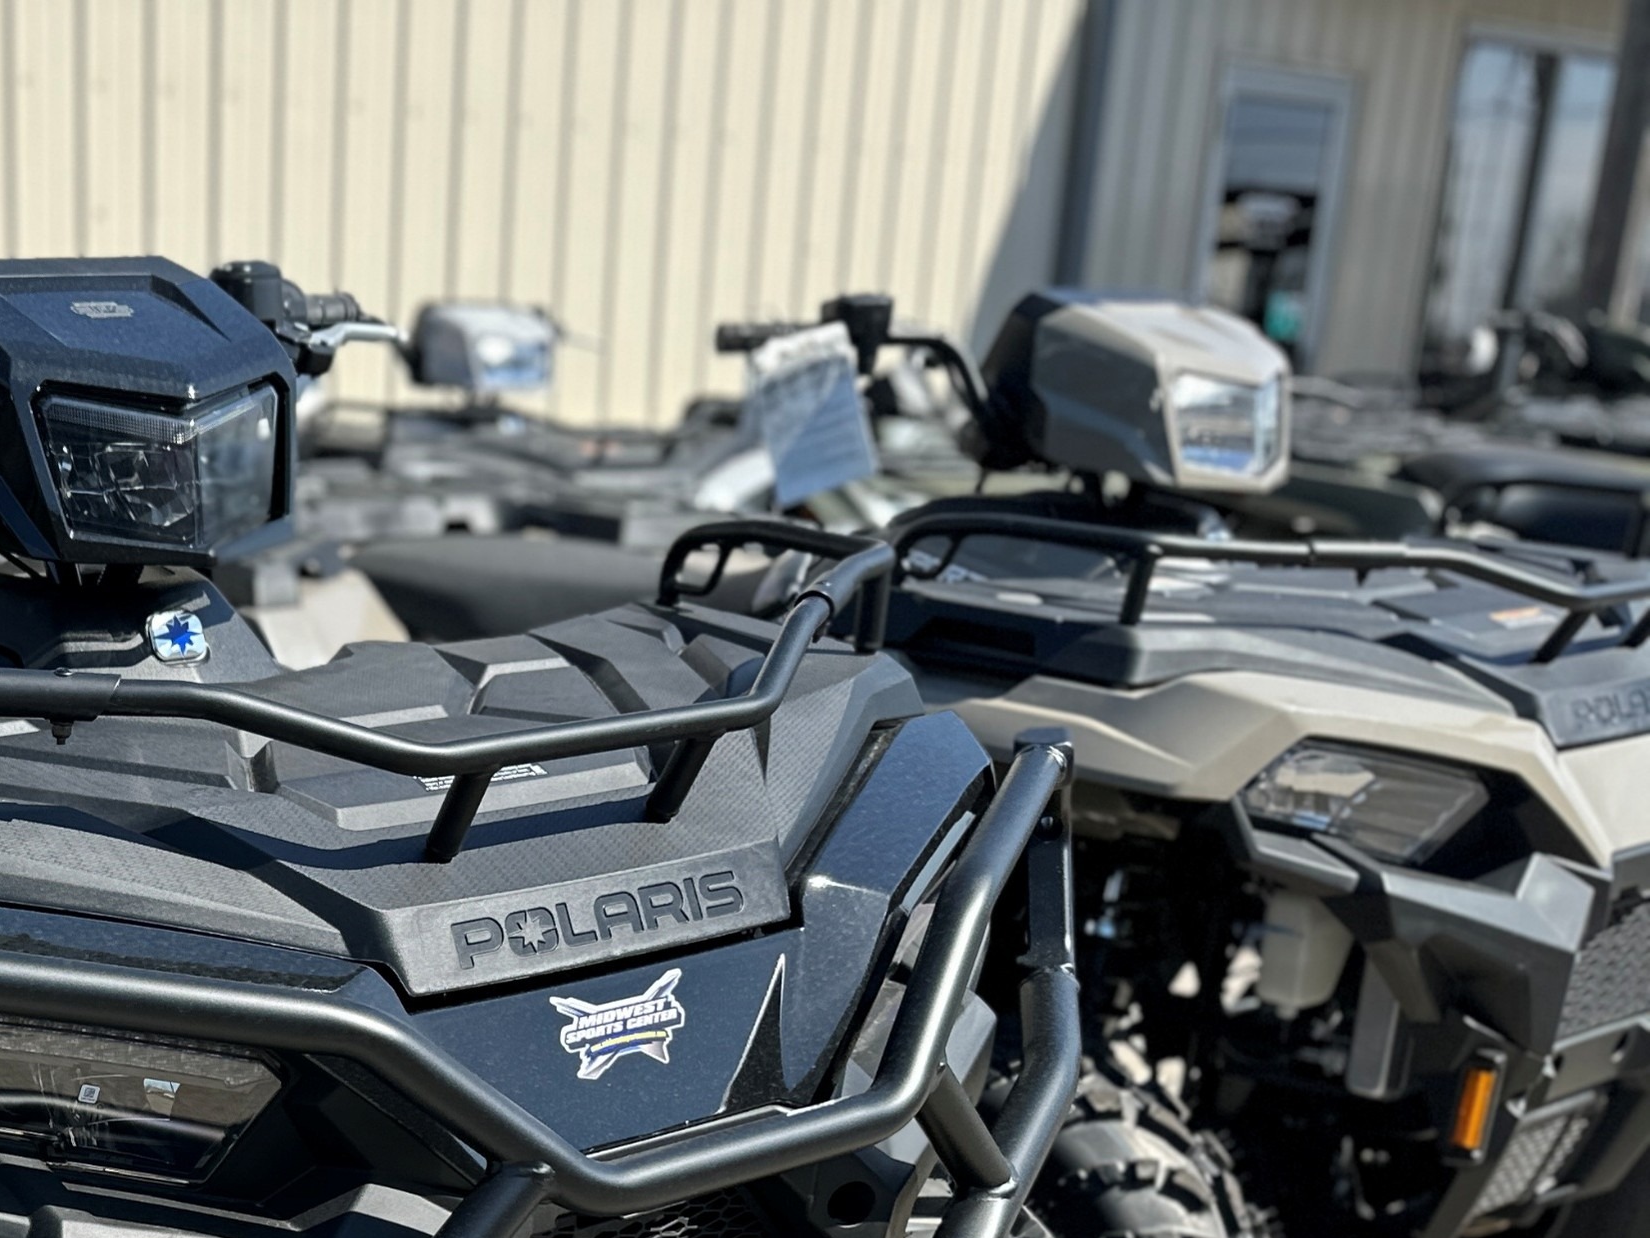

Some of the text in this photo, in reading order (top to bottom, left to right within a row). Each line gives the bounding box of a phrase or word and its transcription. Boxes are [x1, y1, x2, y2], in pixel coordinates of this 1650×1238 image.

[1569, 687, 1650, 730] POLA
[450, 870, 744, 970] POLARIS
[565, 1020, 624, 1044] SPORTS
[626, 1008, 679, 1030] CENTER
[578, 998, 668, 1030] MIDWEST
